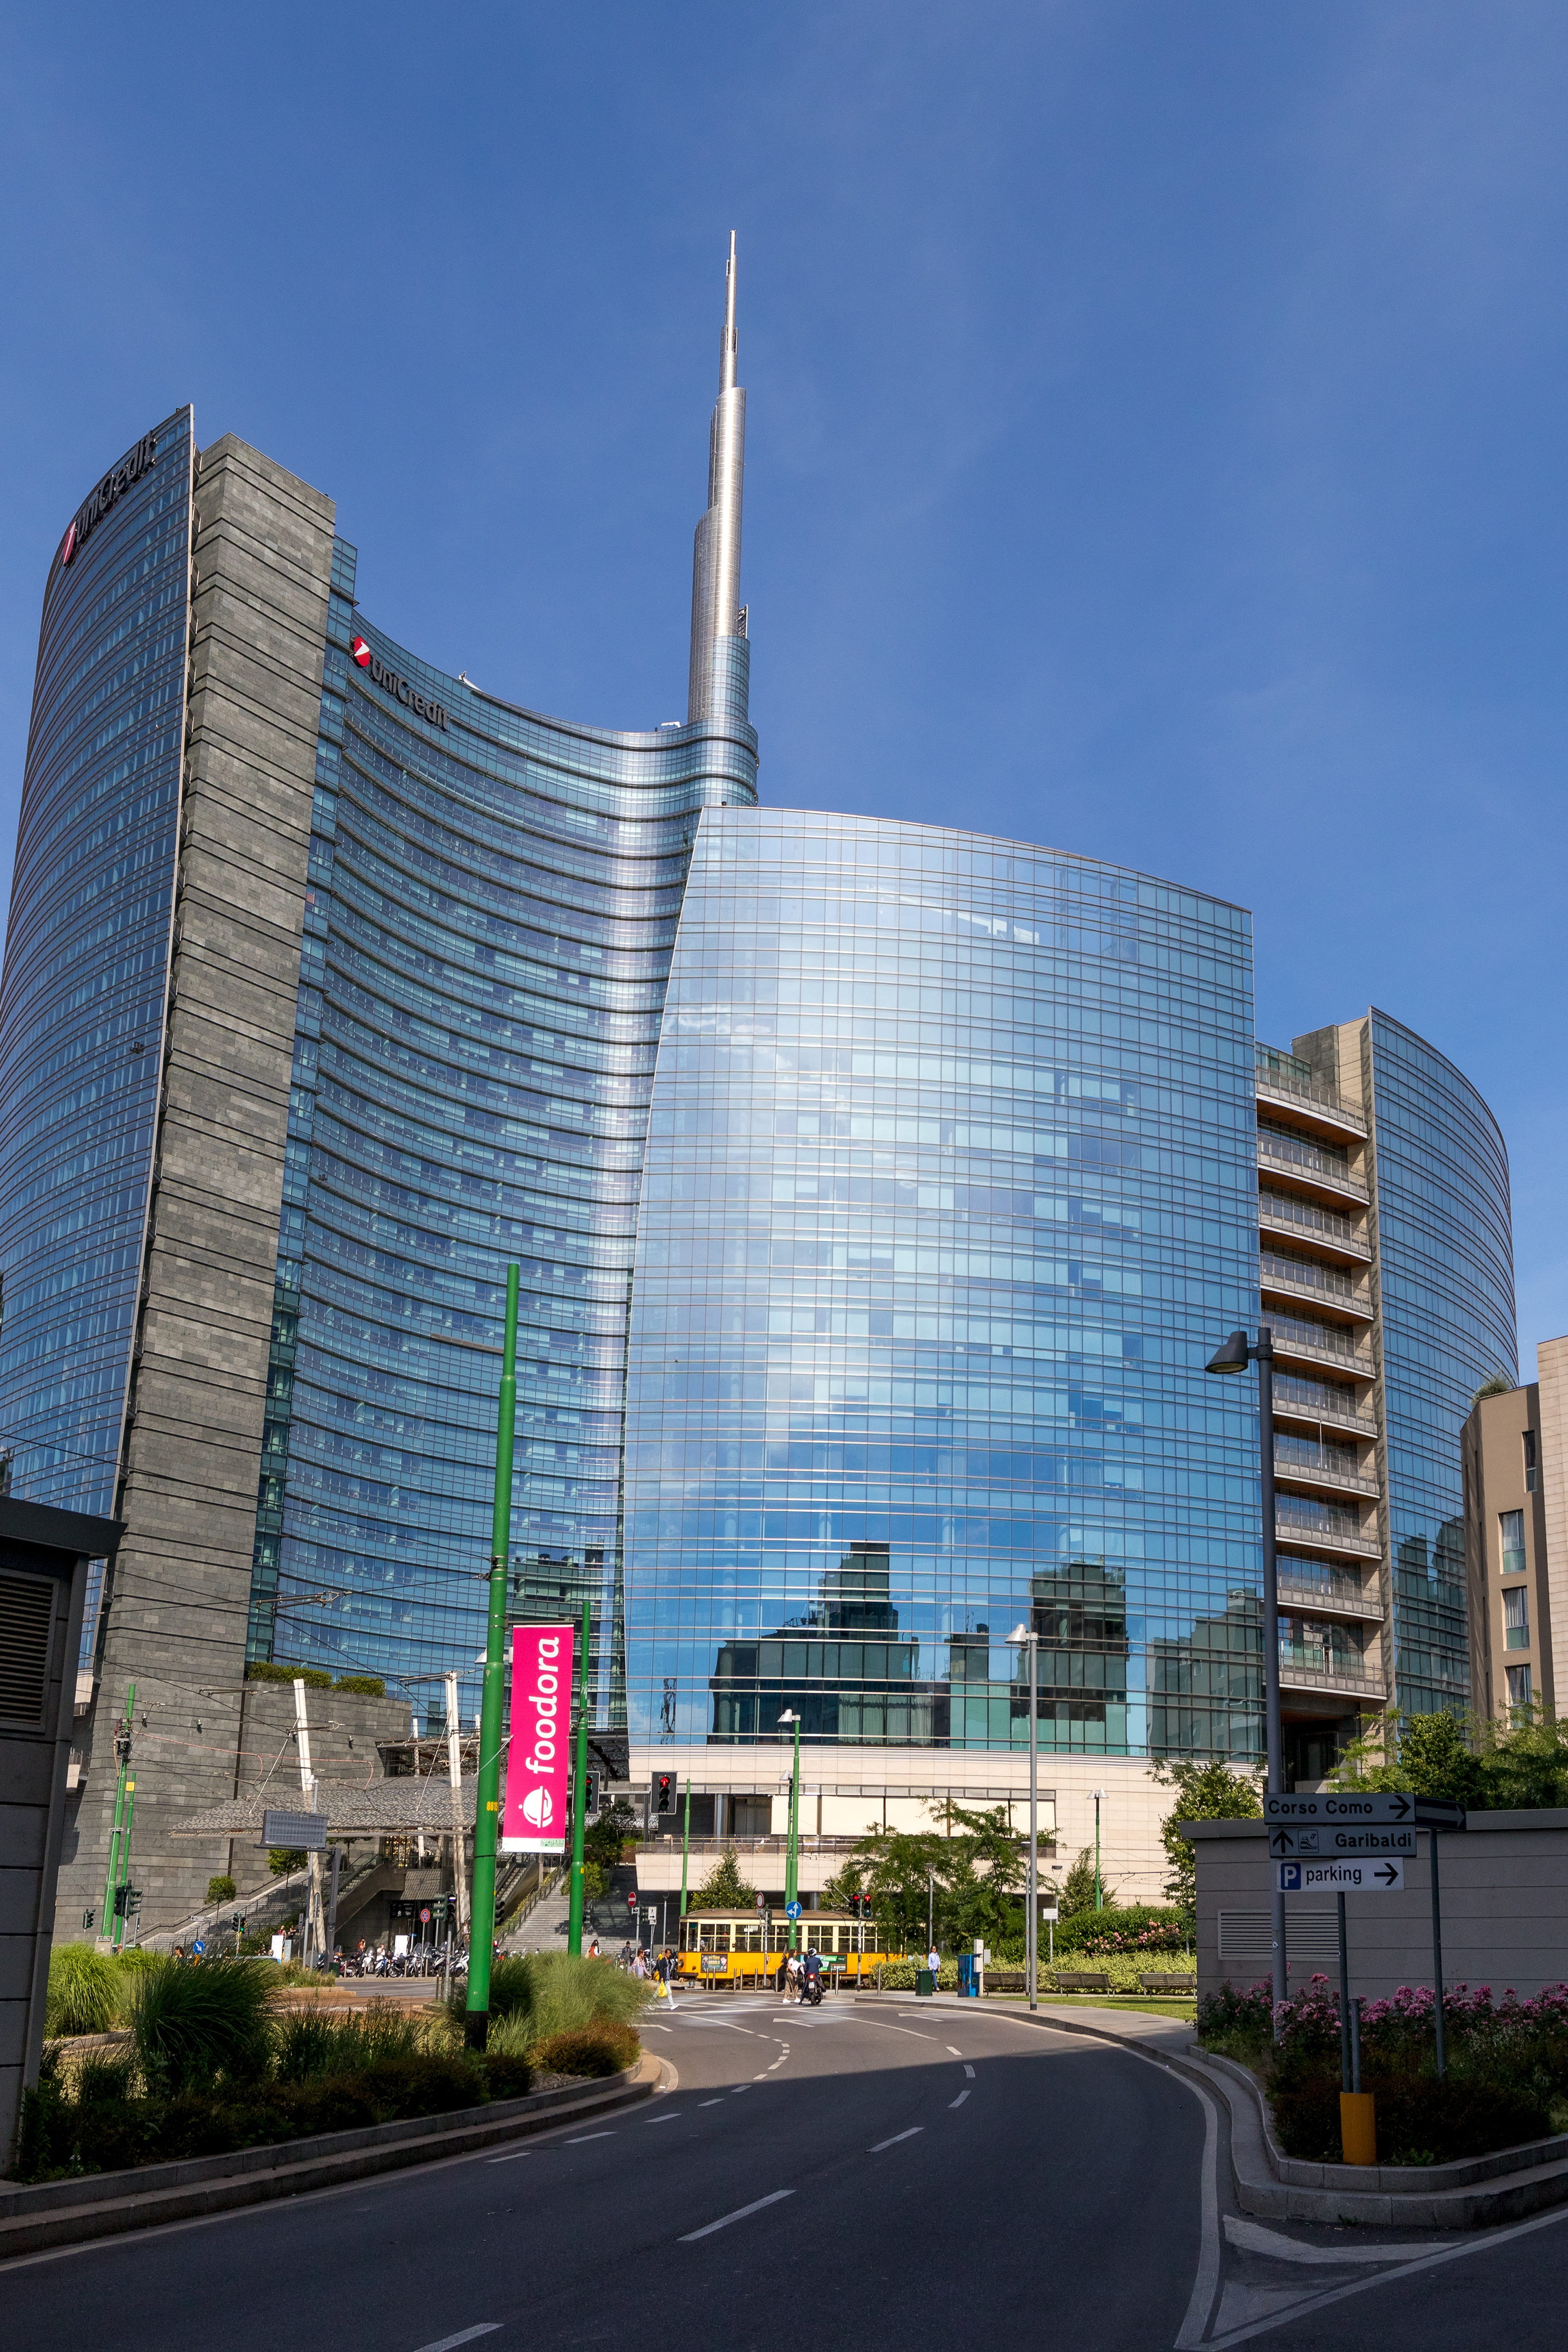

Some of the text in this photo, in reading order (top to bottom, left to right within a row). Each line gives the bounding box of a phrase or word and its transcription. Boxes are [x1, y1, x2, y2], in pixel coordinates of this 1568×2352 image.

[371, 654, 448, 732] UniCredit
[525, 1637, 560, 1774] foodora
[1268, 1799, 1373, 1814] Corso Como
[1335, 1832, 1412, 1848] Garibaldi
[1306, 1866, 1362, 1885] parking
